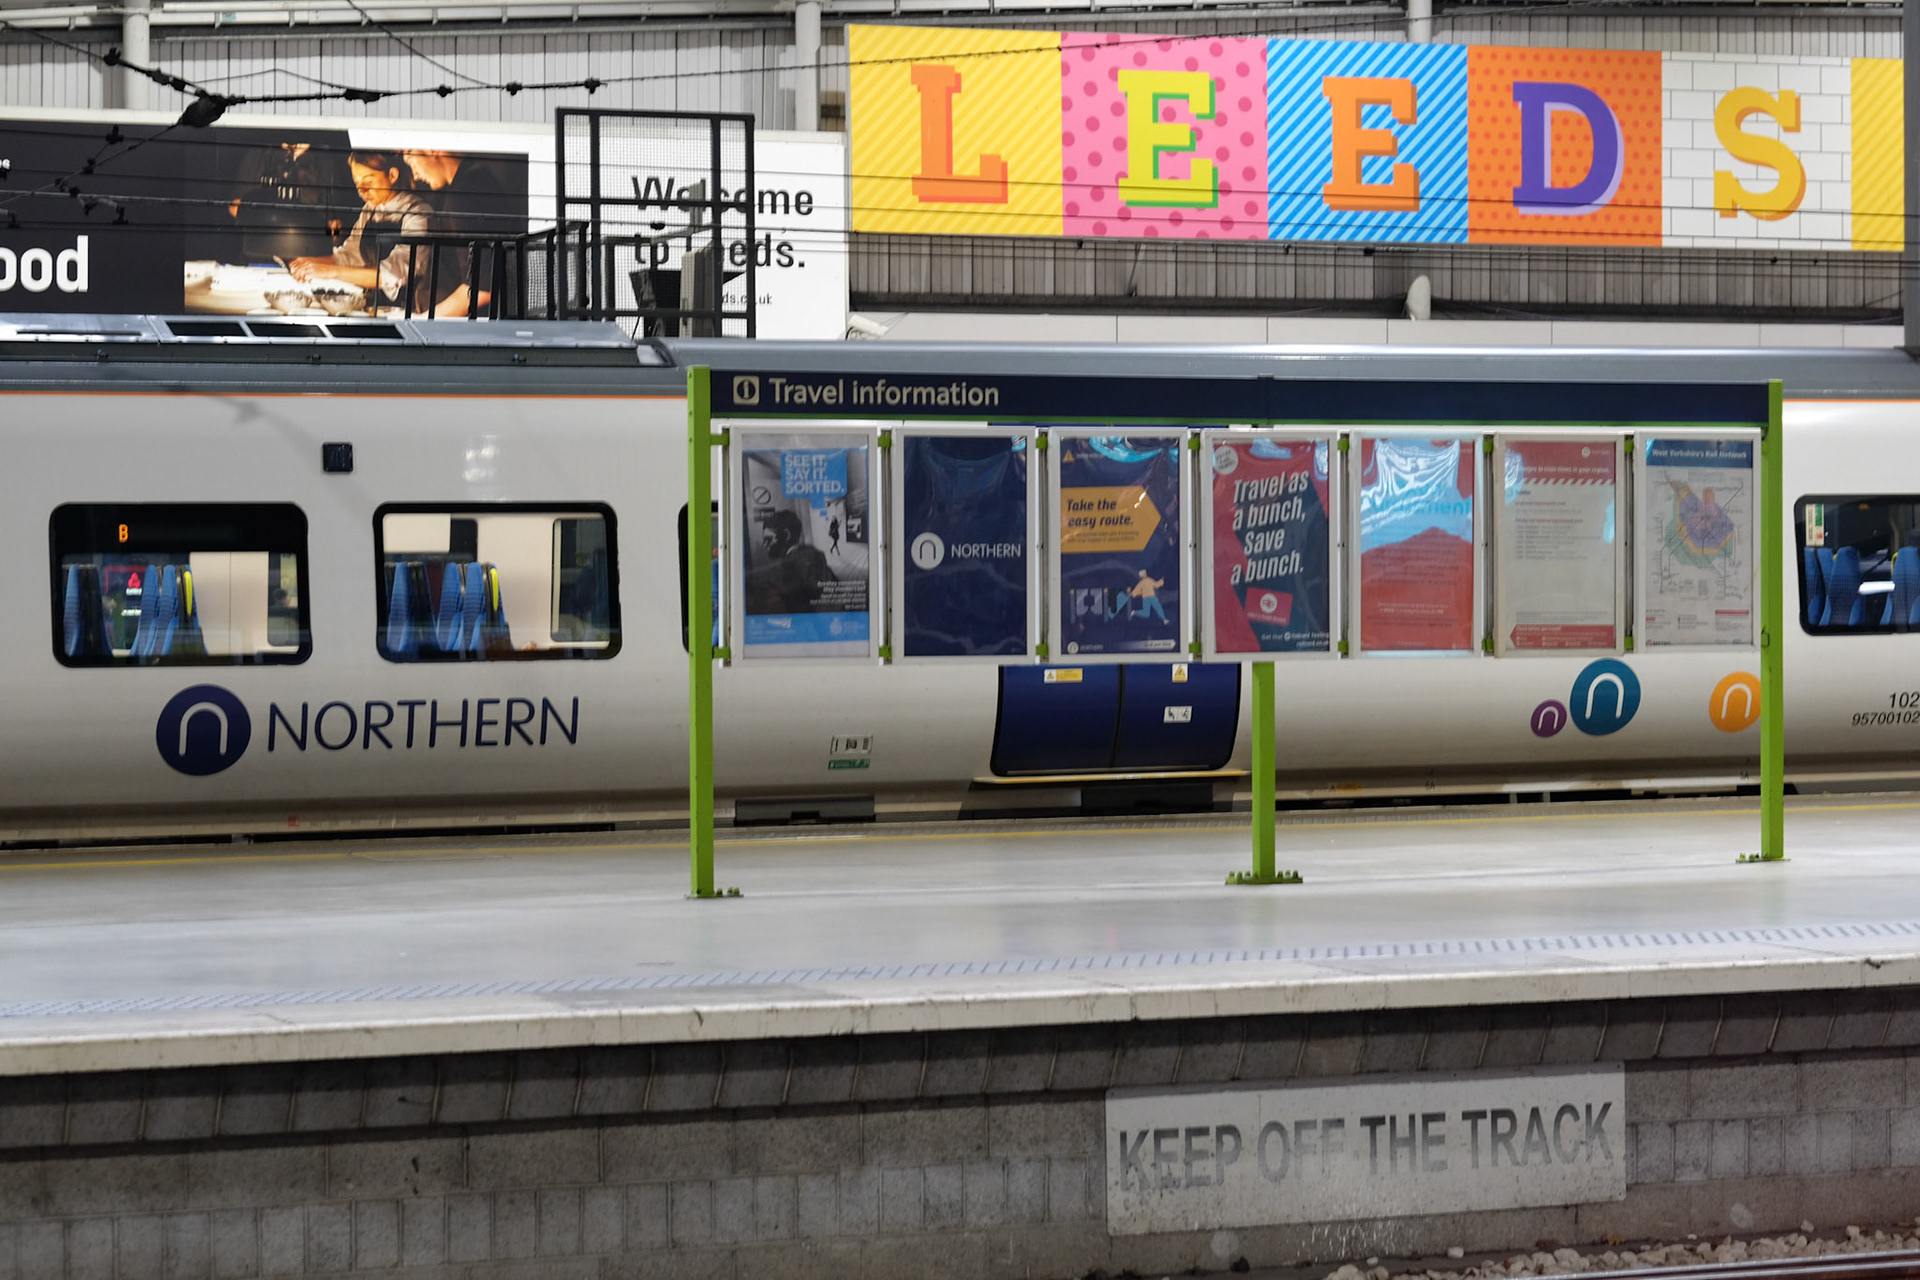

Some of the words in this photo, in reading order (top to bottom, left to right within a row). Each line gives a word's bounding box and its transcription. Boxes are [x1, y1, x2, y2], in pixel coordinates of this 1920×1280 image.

[911, 64, 1807, 222] LEEDS
[769, 377, 844, 405] Travel
[852, 378, 999, 406] information
[785, 454, 810, 467] SEE
[785, 467, 810, 480] SAY
[785, 480, 845, 494] SORTED.
[1233, 471, 1286, 503] Travel
[1288, 470, 1309, 494] as
[1067, 498, 1094, 511] Take
[1097, 498, 1117, 511] the
[1232, 508, 1244, 531] a
[1247, 495, 1306, 528] bunch,
[1067, 516, 1097, 529] easy
[1099, 513, 1134, 526] route.
[951, 543, 1021, 559] NORTHERN
[1243, 528, 1285, 556] Save
[1230, 563, 1242, 586] a
[1244, 549, 1304, 584] bunch.
[1890, 691, 1920, 708] 102
[268, 696, 579, 752] NORTHERN
[1119, 1124, 1242, 1191] KEEP
[1257, 1117, 1345, 1182] OFF
[1360, 1112, 1448, 1175] THE
[1461, 1101, 1613, 1169] TRACK
